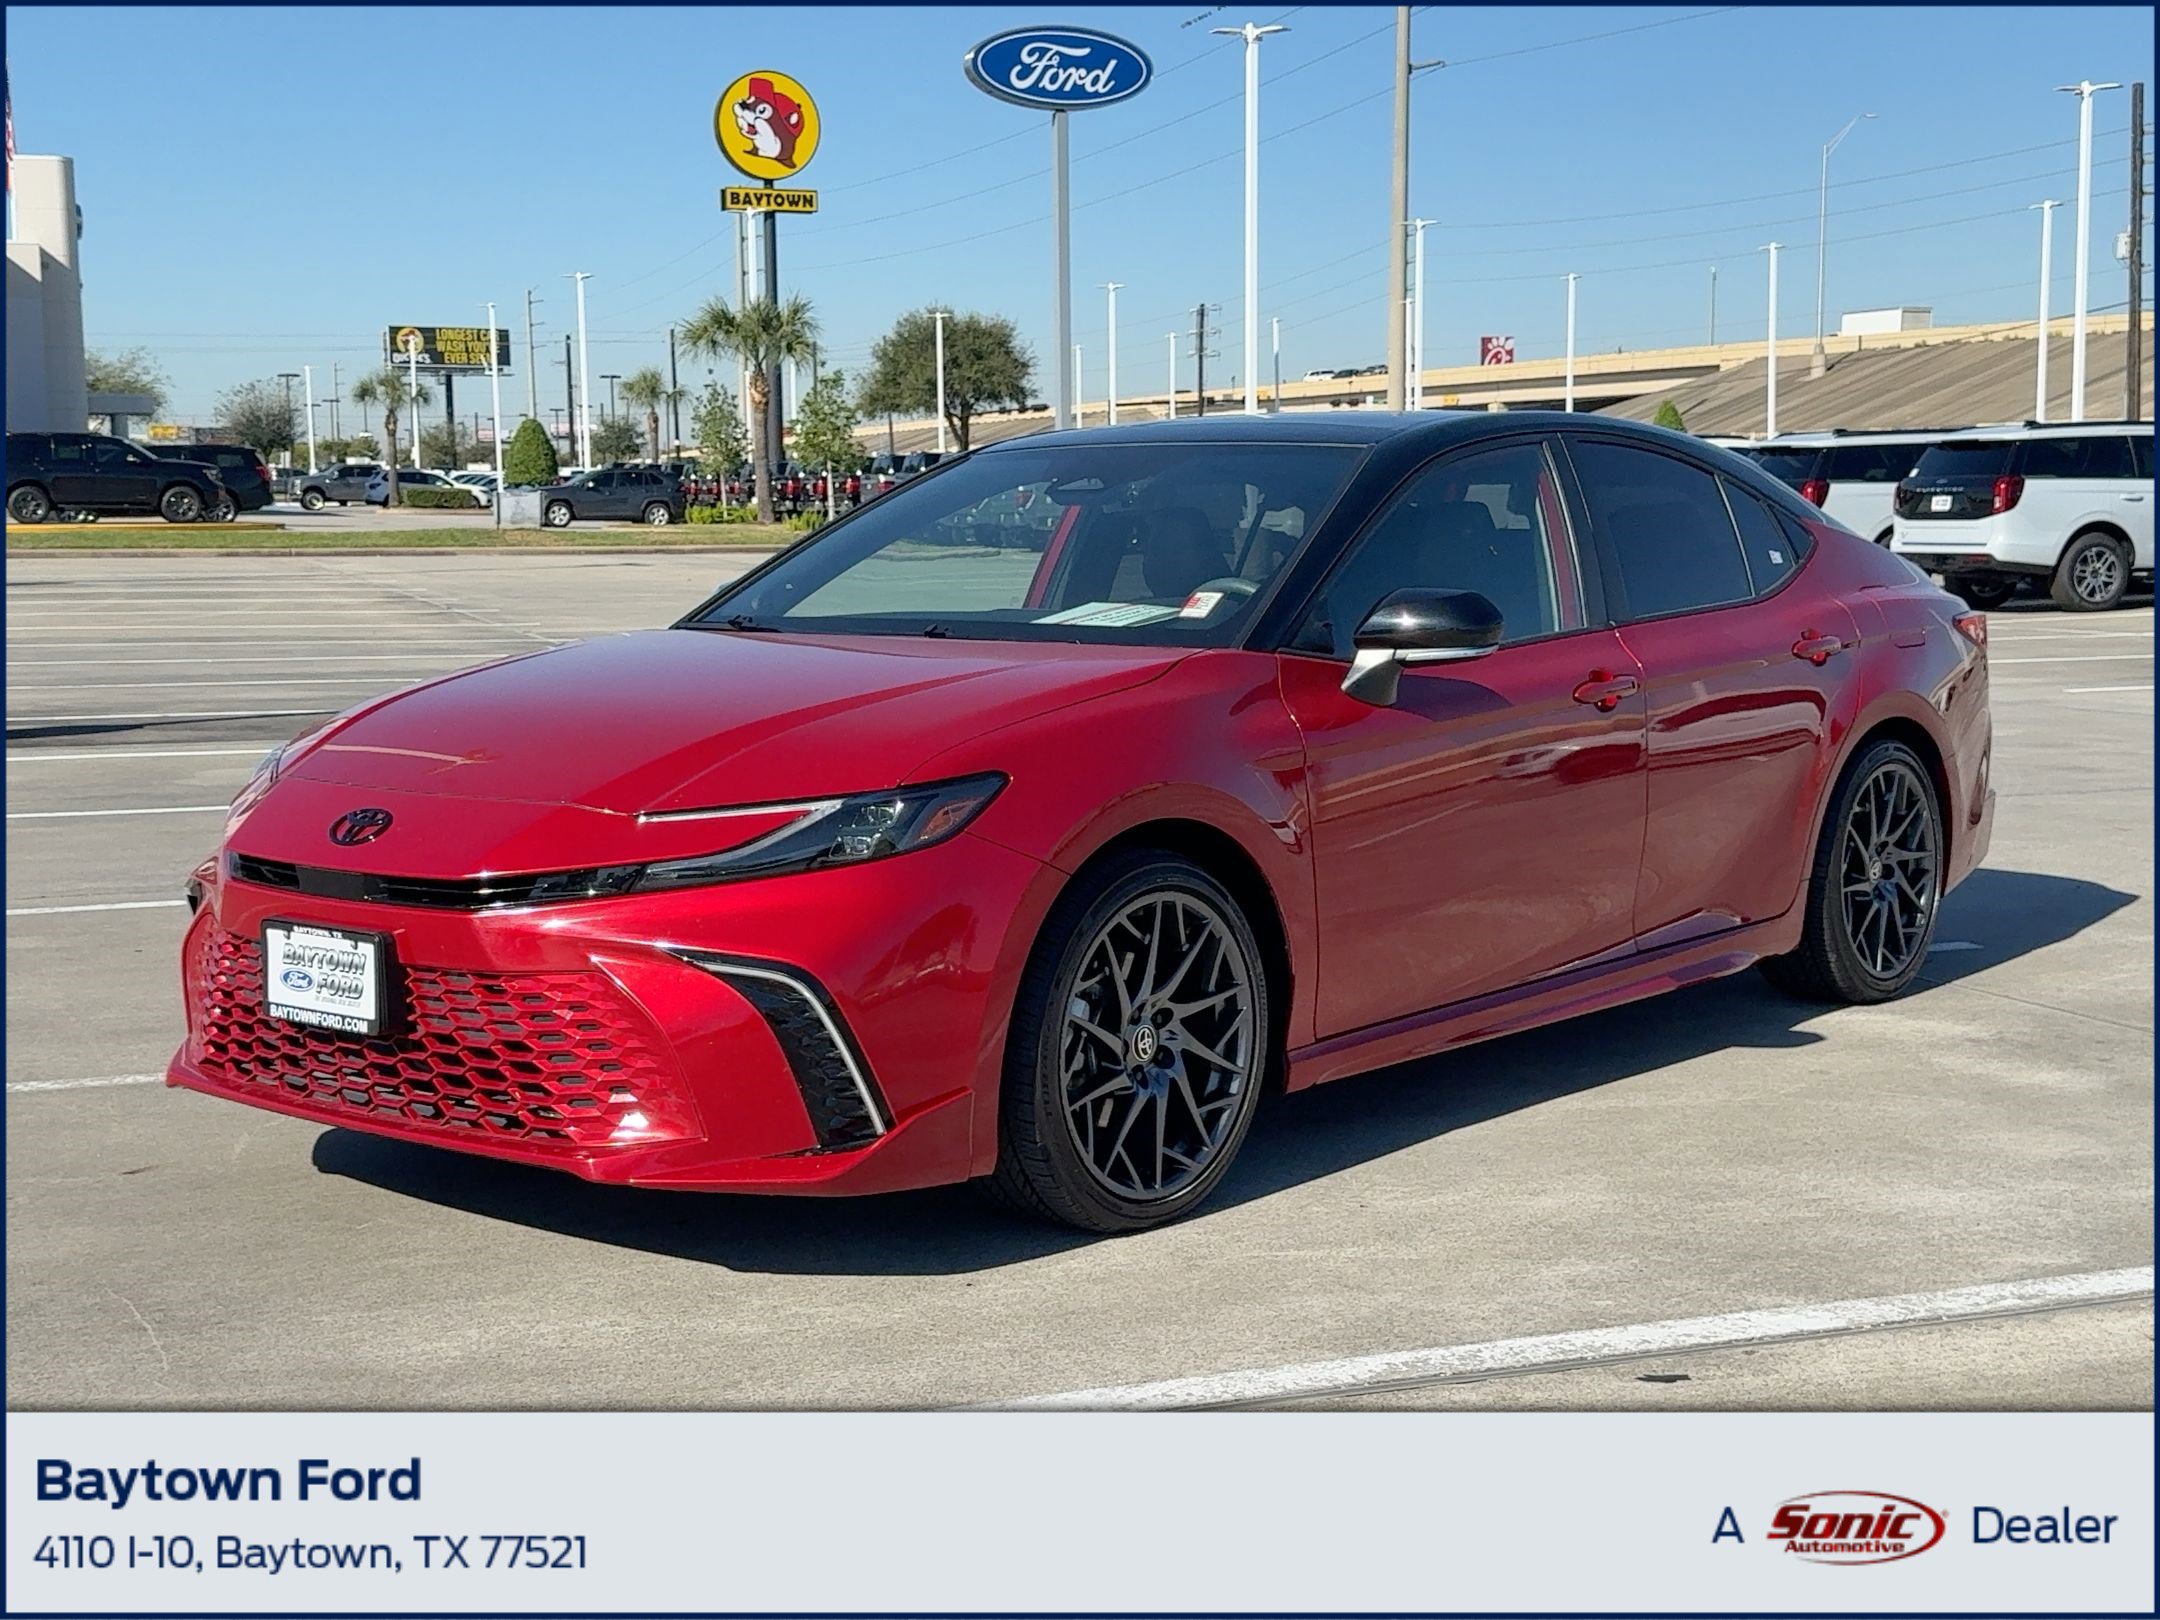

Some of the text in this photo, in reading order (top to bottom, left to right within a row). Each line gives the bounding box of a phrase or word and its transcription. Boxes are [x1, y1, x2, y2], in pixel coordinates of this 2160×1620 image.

[1009, 41, 1118, 94] Ford
[730, 191, 814, 208] BAYTOWN
[436, 328, 478, 341] LONGEST
[436, 340, 466, 352] WASH
[444, 352, 468, 364] EVER
[282, 943, 367, 975] BAYTOWN
[316, 972, 364, 1000] FORD
[269, 1004, 369, 1034] BAYTOWNFORD.COM
